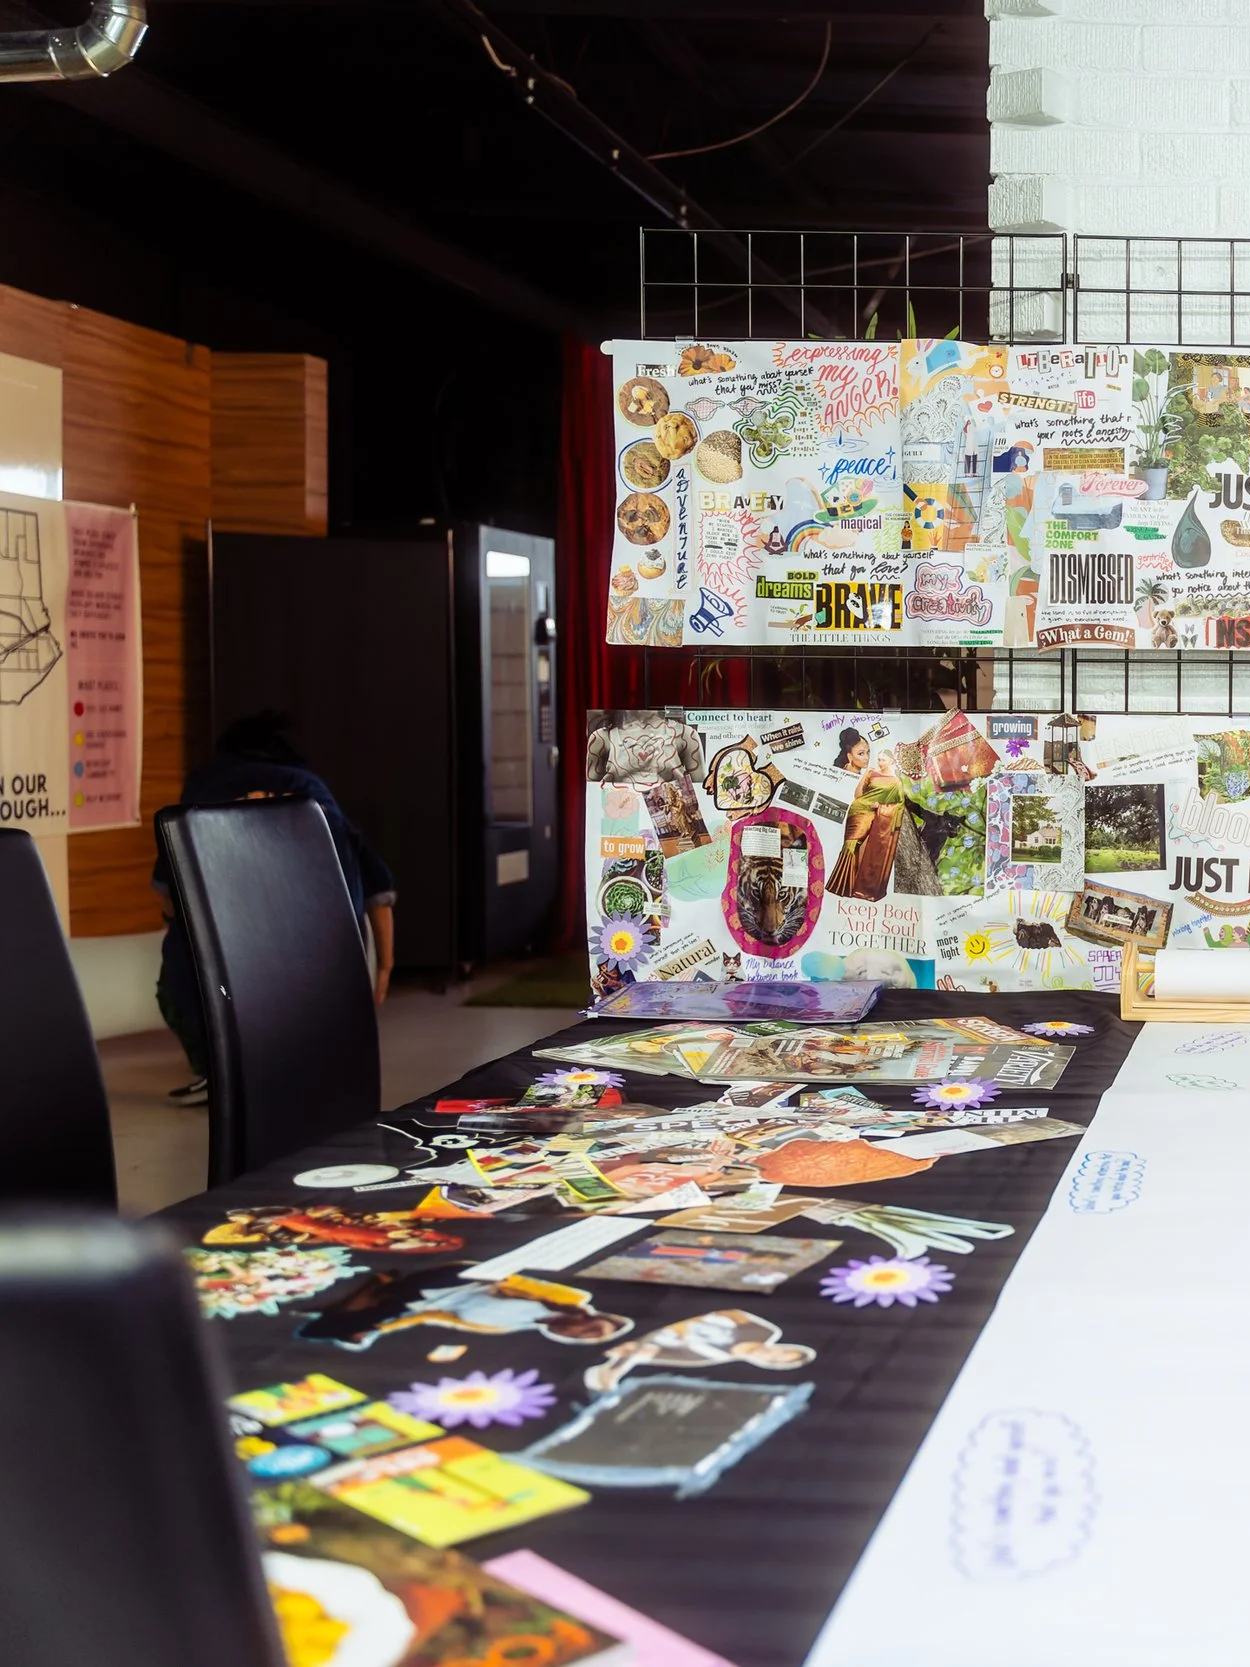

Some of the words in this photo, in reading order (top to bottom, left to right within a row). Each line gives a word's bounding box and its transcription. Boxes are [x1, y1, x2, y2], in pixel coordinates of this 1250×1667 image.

[784, 345, 885, 374] expressing
[637, 364, 677, 377] Fresh
[688, 376, 713, 387] what's
[717, 372, 759, 387] something
[760, 369, 782, 380] about
[784, 365, 816, 384] yourself
[818, 363, 858, 393] my
[714, 383, 737, 395] that
[740, 383, 755, 396] you
[758, 378, 783, 390] miss?
[999, 392, 1077, 414] STRENGTH
[1075, 391, 1096, 408] life
[1014, 418, 1039, 430] what's
[1046, 415, 1096, 428] something
[1100, 413, 1123, 424] that
[826, 456, 893, 484] peace
[1081, 474, 1146, 496] Forever
[840, 517, 883, 533] magical
[1046, 521, 1067, 531] THE
[1045, 540, 1074, 550] ZONE
[1046, 531, 1099, 541] COMFORT
[803, 551, 828, 560] what's
[832, 551, 877, 564] something
[881, 551, 901, 560] about
[903, 550, 935, 562] yourself
[788, 572, 816, 581] BOLD
[821, 562, 845, 576] that
[850, 563, 867, 581] you
[870, 560, 908, 576] love?
[1050, 554, 1134, 605] DISMISSED
[1156, 571, 1181, 582] what's
[1184, 569, 1228, 583] something
[757, 577, 814, 599] dreams
[1171, 585, 1184, 597] you
[1187, 582, 1213, 593] notice
[1217, 580, 1241, 591] about
[815, 583, 902, 629] BRAVE
[911, 592, 987, 621] creativity
[790, 633, 810, 643] THE
[813, 633, 851, 643] LITTLE
[853, 633, 891, 643] THINGS
[1045, 626, 1082, 643] What
[1084, 631, 1093, 639] a
[1094, 625, 1130, 642] Gem!
[687, 712, 730, 722] Connect
[733, 713, 744, 722] to
[746, 712, 773, 722] heart
[821, 714, 845, 732] family
[850, 714, 883, 728] photos
[992, 721, 1032, 737] growing
[11, 774, 47, 796] OUR
[603, 840, 615, 853] to
[618, 842, 644, 856] grow
[1169, 856, 1240, 893] JUST
[837, 901, 878, 918] Keep
[883, 904, 920, 922] Body
[845, 916, 876, 934] And
[881, 919, 916, 938] Soul
[829, 931, 927, 955] TOGETHER
[936, 936, 959, 947] more
[660, 939, 717, 979] Natural
[940, 946, 959, 960] light
[994, 1050, 1055, 1086] VARIETY
